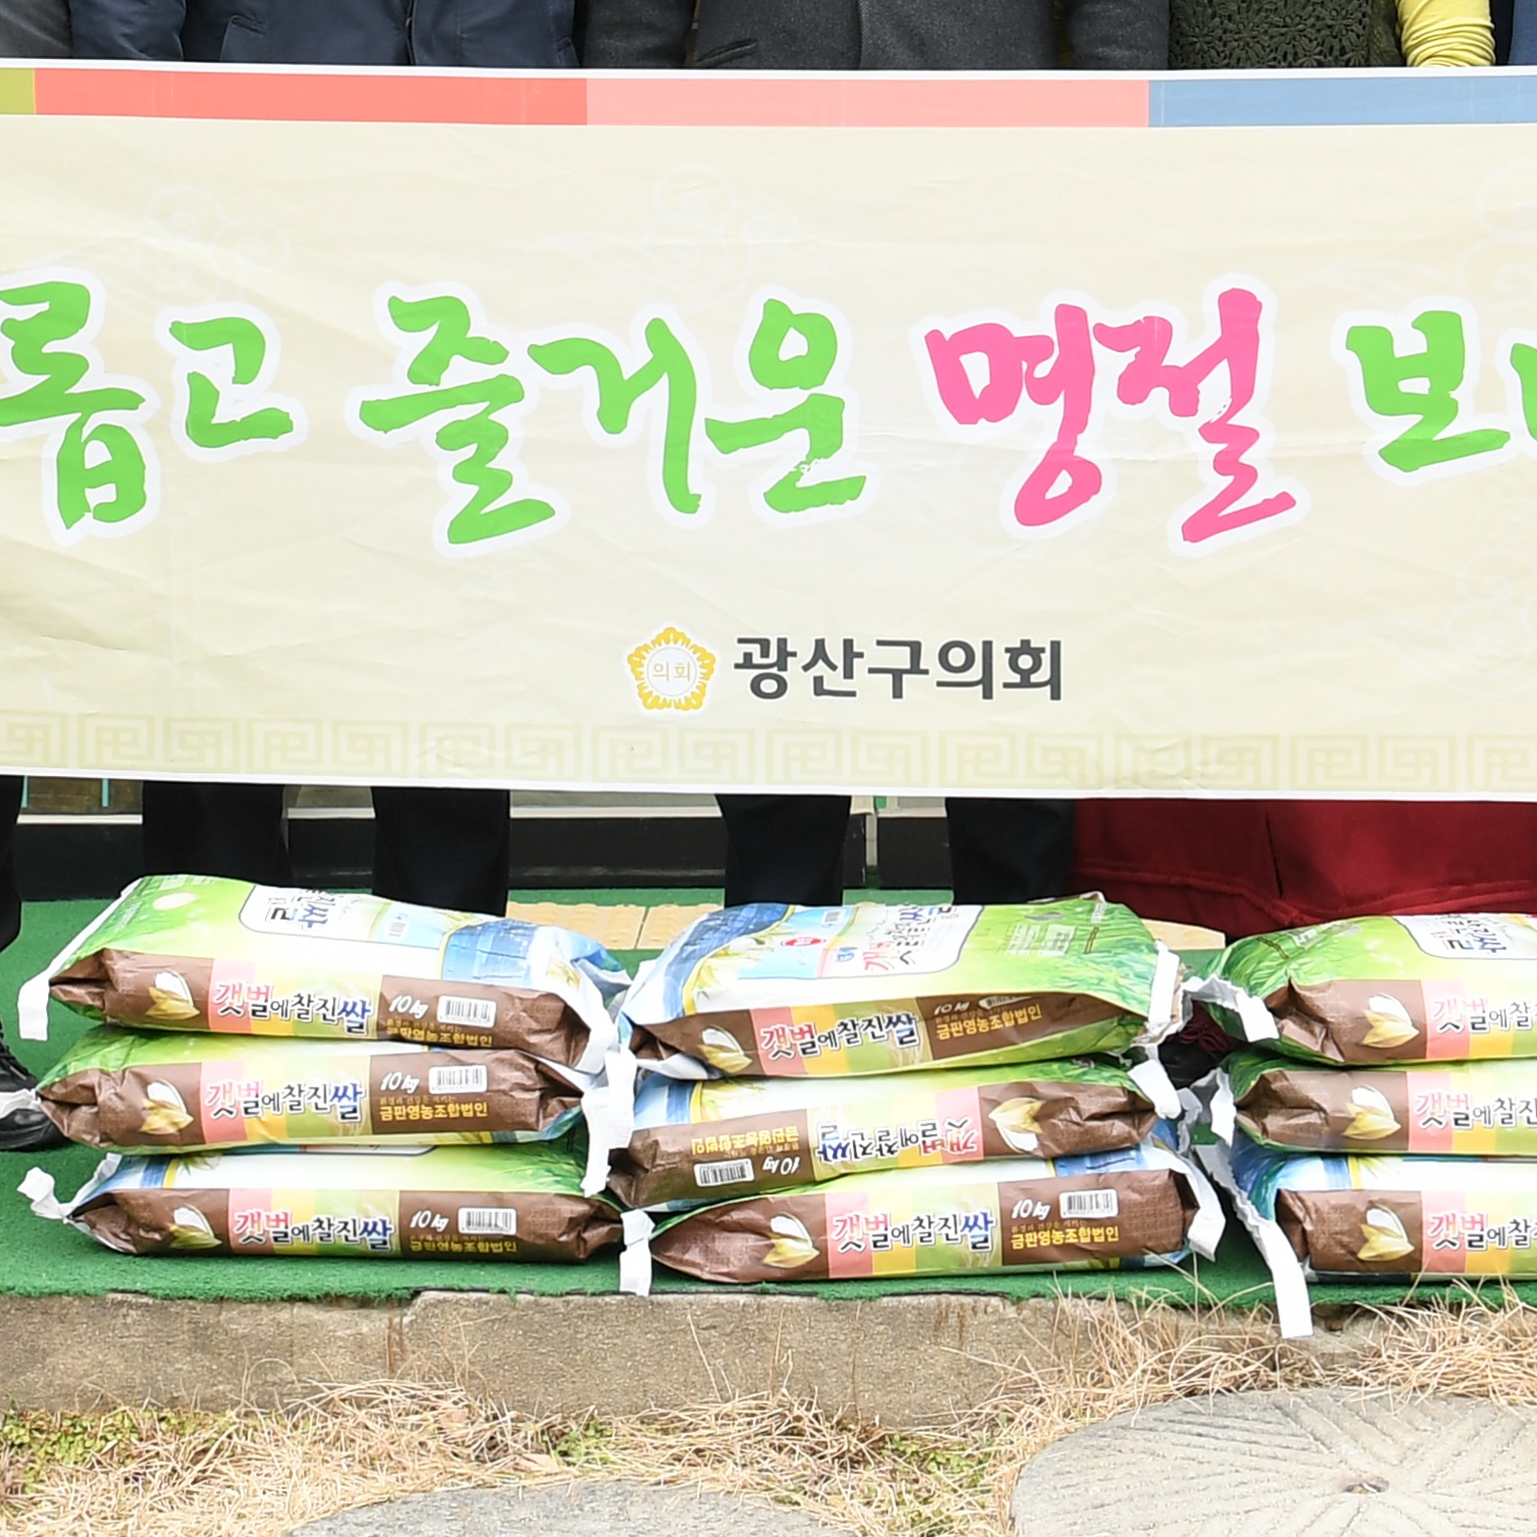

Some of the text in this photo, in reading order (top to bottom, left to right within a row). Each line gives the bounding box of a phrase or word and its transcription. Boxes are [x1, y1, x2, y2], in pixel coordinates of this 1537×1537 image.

[359, 293, 868, 546] 즐거운
[923, 287, 1297, 545] 명절
[733, 637, 1062, 701] 광산구의회
